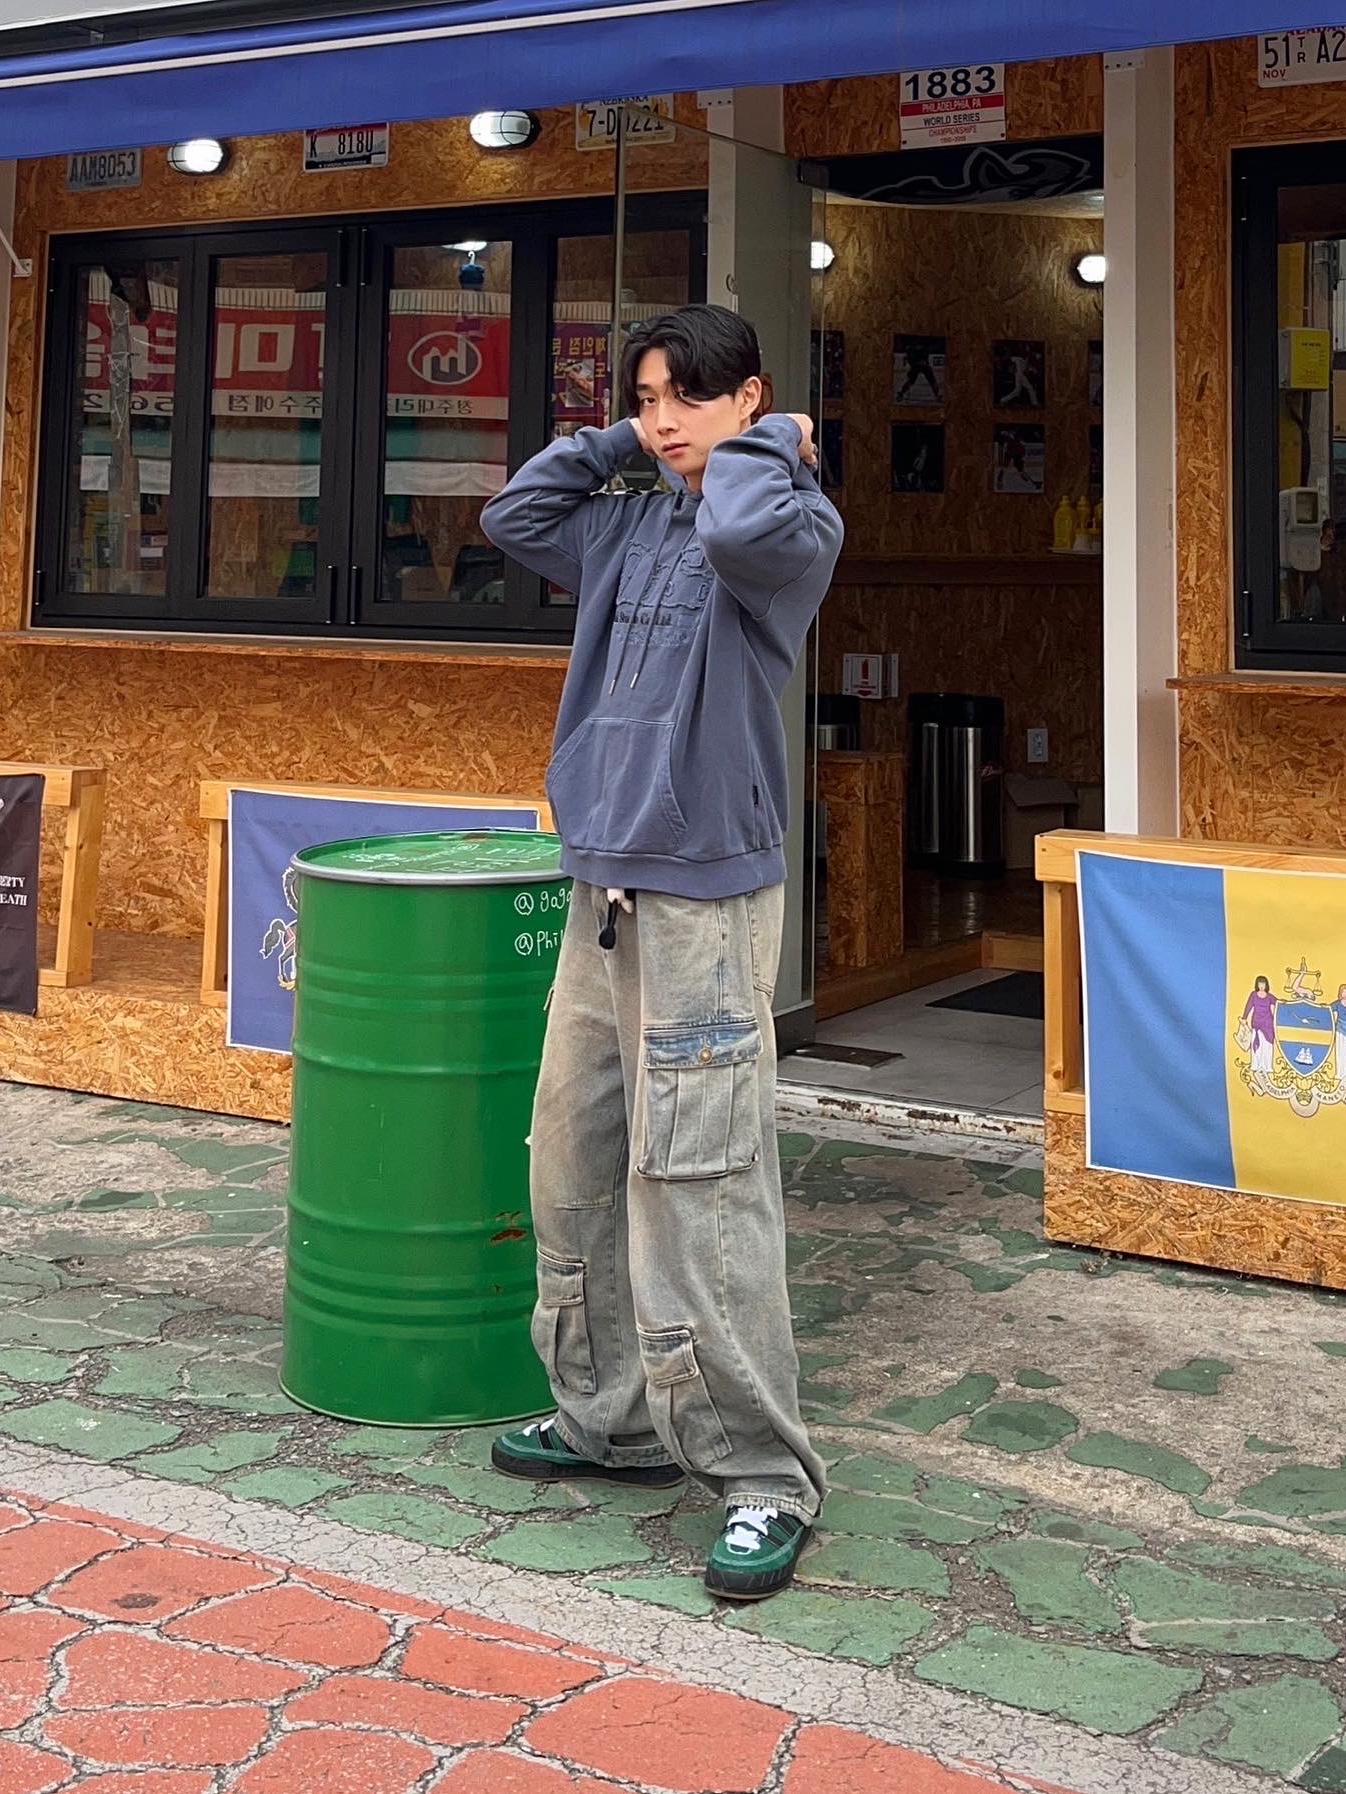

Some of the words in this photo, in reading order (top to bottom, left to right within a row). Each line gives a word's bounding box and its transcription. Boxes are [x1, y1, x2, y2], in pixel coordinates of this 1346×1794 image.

[1264, 35, 1290, 68] 51
[1262, 69, 1286, 79] NOV
[905, 66, 996, 100] 1883
[972, 98, 982, 108] PA
[923, 116, 951, 126] WORLD
[953, 113, 980, 123] SERIES
[929, 126, 977, 137] CHAMPIONSHIPS
[309, 134, 318, 159] K
